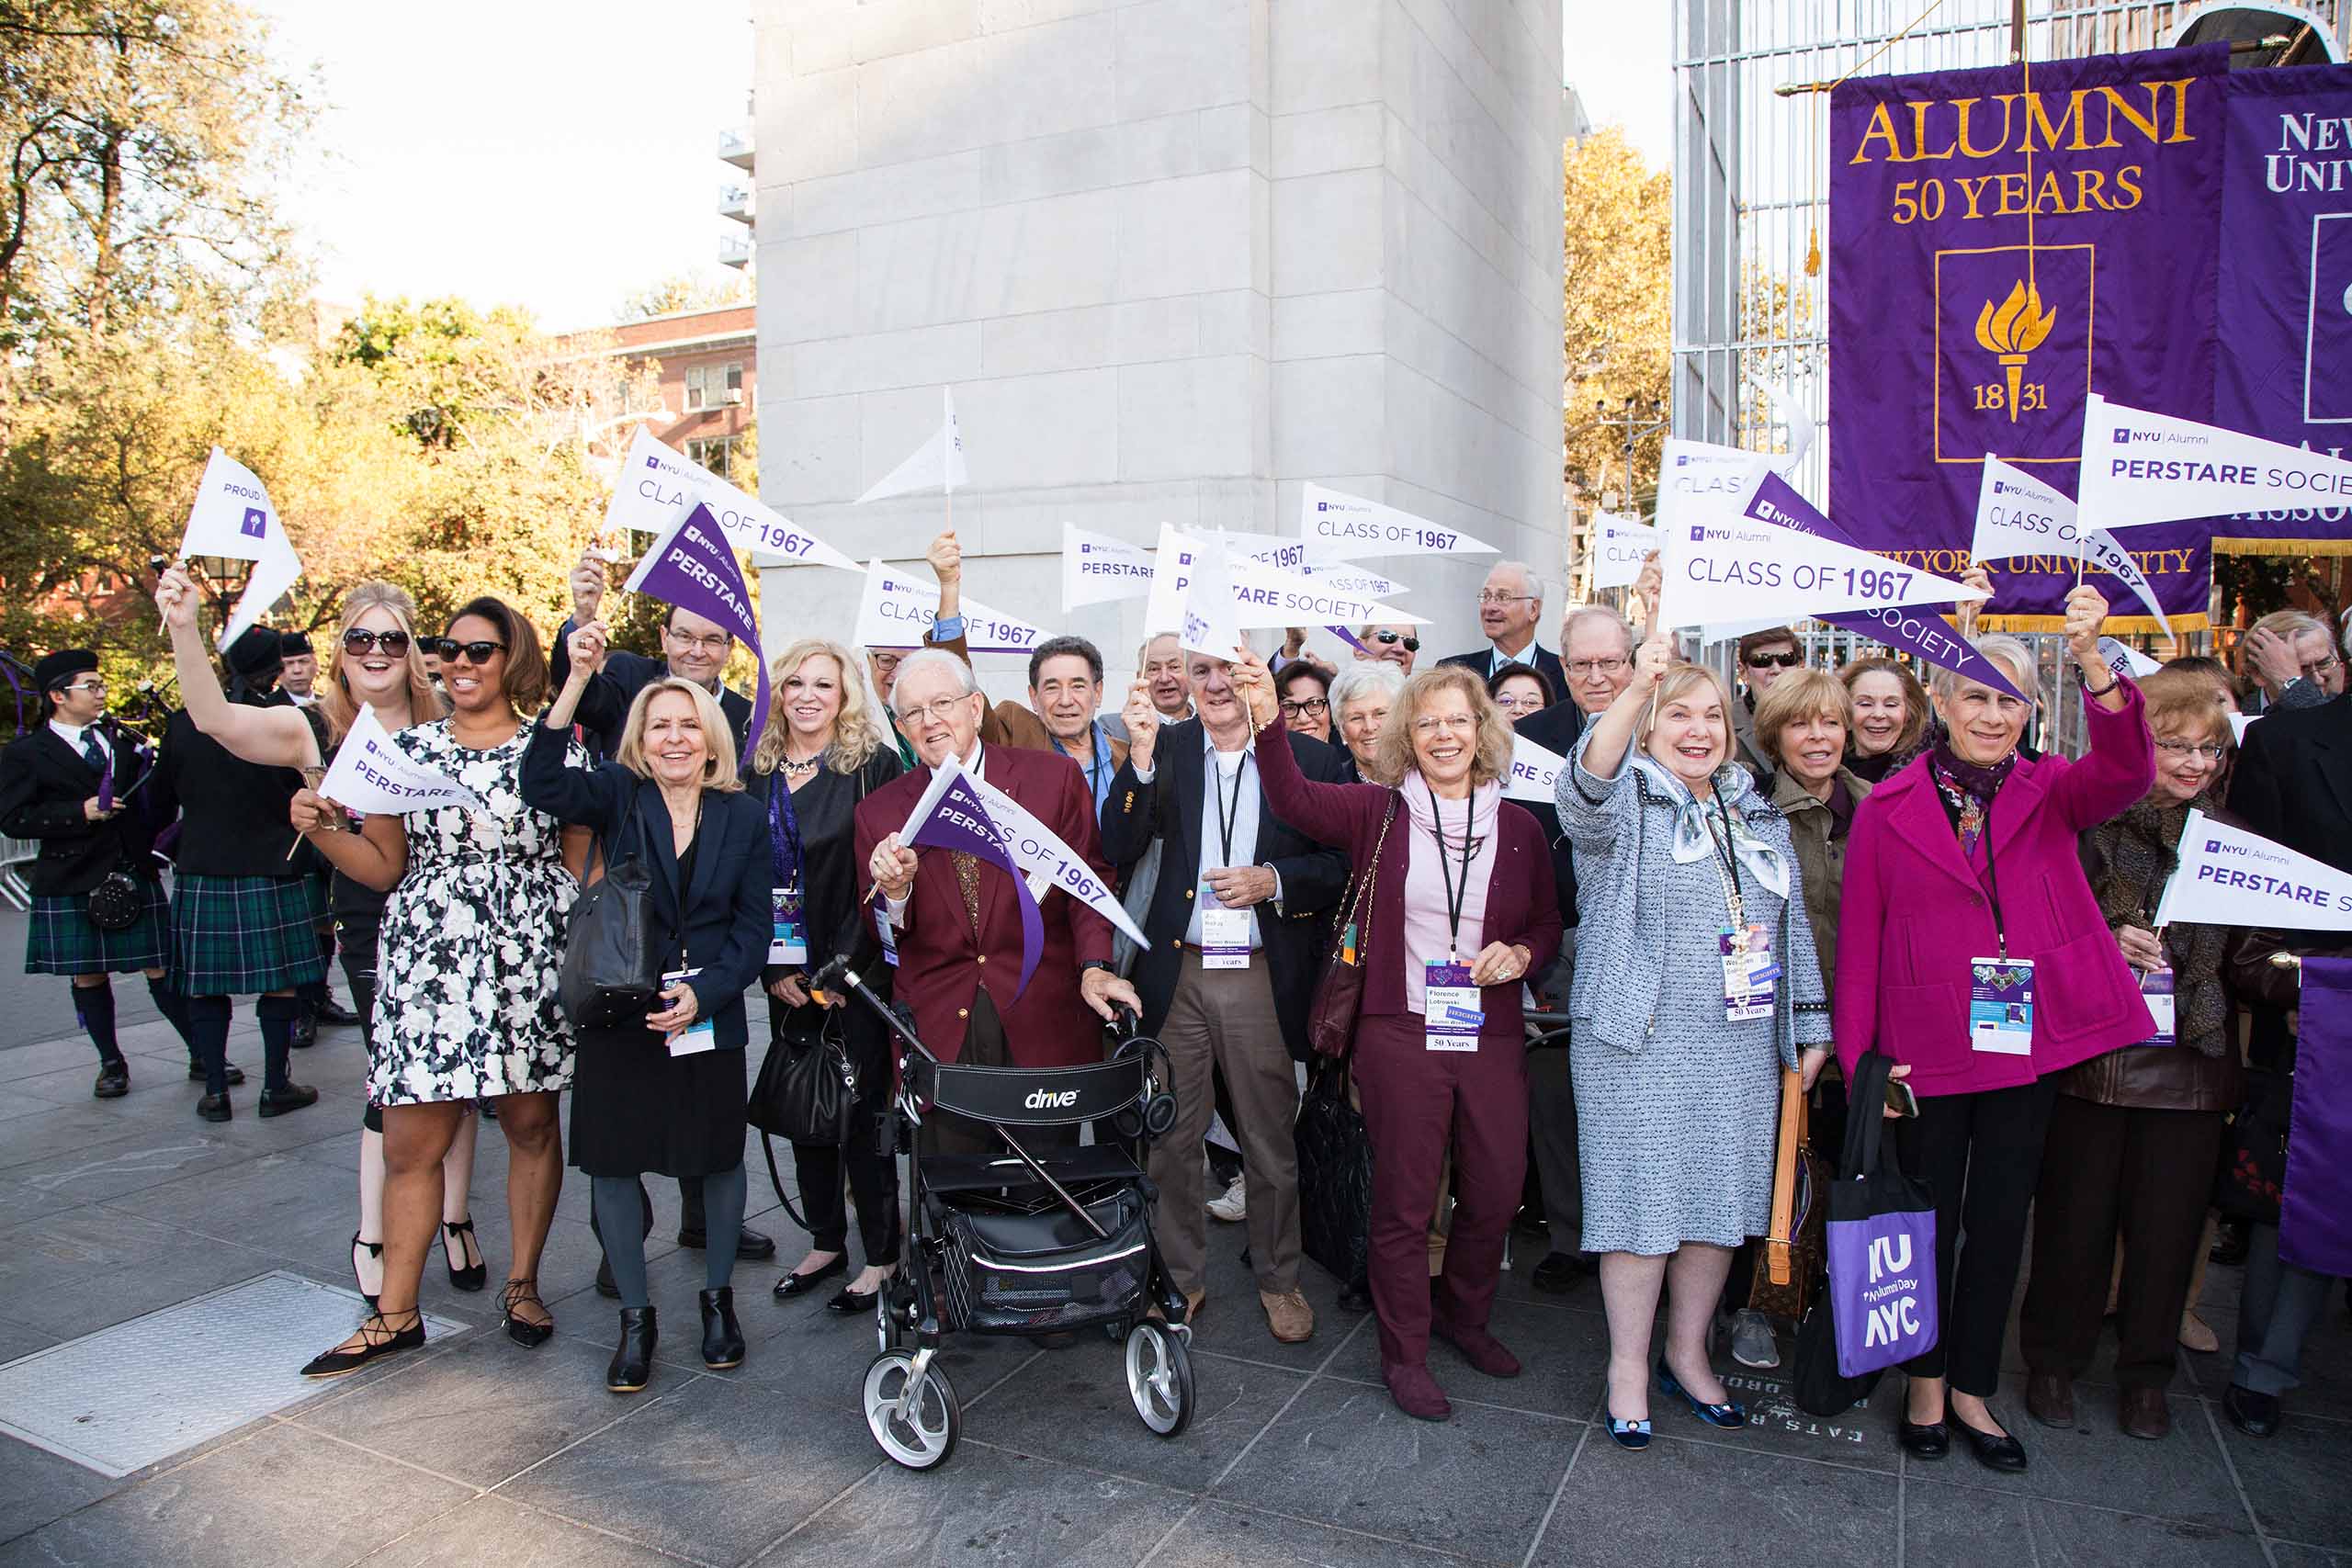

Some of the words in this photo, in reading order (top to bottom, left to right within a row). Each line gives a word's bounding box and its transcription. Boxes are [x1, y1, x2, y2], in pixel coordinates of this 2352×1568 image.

[1849, 77, 2198, 165] ALUMNI
[2264, 154, 2352, 193] UNI
[1892, 178, 1946, 224] 50
[1953, 165, 2143, 220] YEARS
[2132, 432, 2161, 442] NYU
[2167, 434, 2209, 445] Alumni
[2111, 459, 2257, 485] PERSTARE
[223, 483, 261, 501] PROUD
[2004, 485, 2021, 495] NYU
[1772, 511, 1800, 529] NYU
[696, 536, 718, 555] NYU
[721, 511, 755, 532] OF
[758, 524, 814, 557] 1967
[1317, 521, 1379, 539] CLASS
[1385, 526, 1411, 541] OF
[1416, 530, 1457, 550] 1967
[1707, 529, 1730, 540] NYU
[1736, 532, 1771, 543] Alumni
[1272, 545, 1304, 568] 1967
[1991, 507, 2053, 534] CLASS
[2096, 544, 2144, 587] 1967
[667, 547, 752, 631] PERSTARE
[1370, 580, 1390, 593] 1967
[1688, 558, 1781, 587] CLASS
[1793, 565, 1836, 591] OF
[1843, 567, 1913, 601] 1967
[1286, 593, 1374, 619] SOCIETY
[987, 622, 1036, 646] 1967
[1866, 607, 1974, 670] SOCIETY
[355, 760, 456, 797] PERSTARE
[964, 797, 982, 813] NYU
[938, 807, 1006, 856] PERSTA
[2222, 844, 2247, 856] NYU
[2252, 849, 2290, 865] Alumni
[1021, 839, 1056, 861] OF
[1056, 860, 1107, 904] 1967
[2198, 864, 2331, 908] PERSTARE
[1745, 1007, 1766, 1015] Years
[1433, 1039, 1444, 1047] 50
[1446, 1039, 1470, 1047] Years
[1025, 1089, 1077, 1109] drive
[1897, 1279, 1918, 1292] Day
